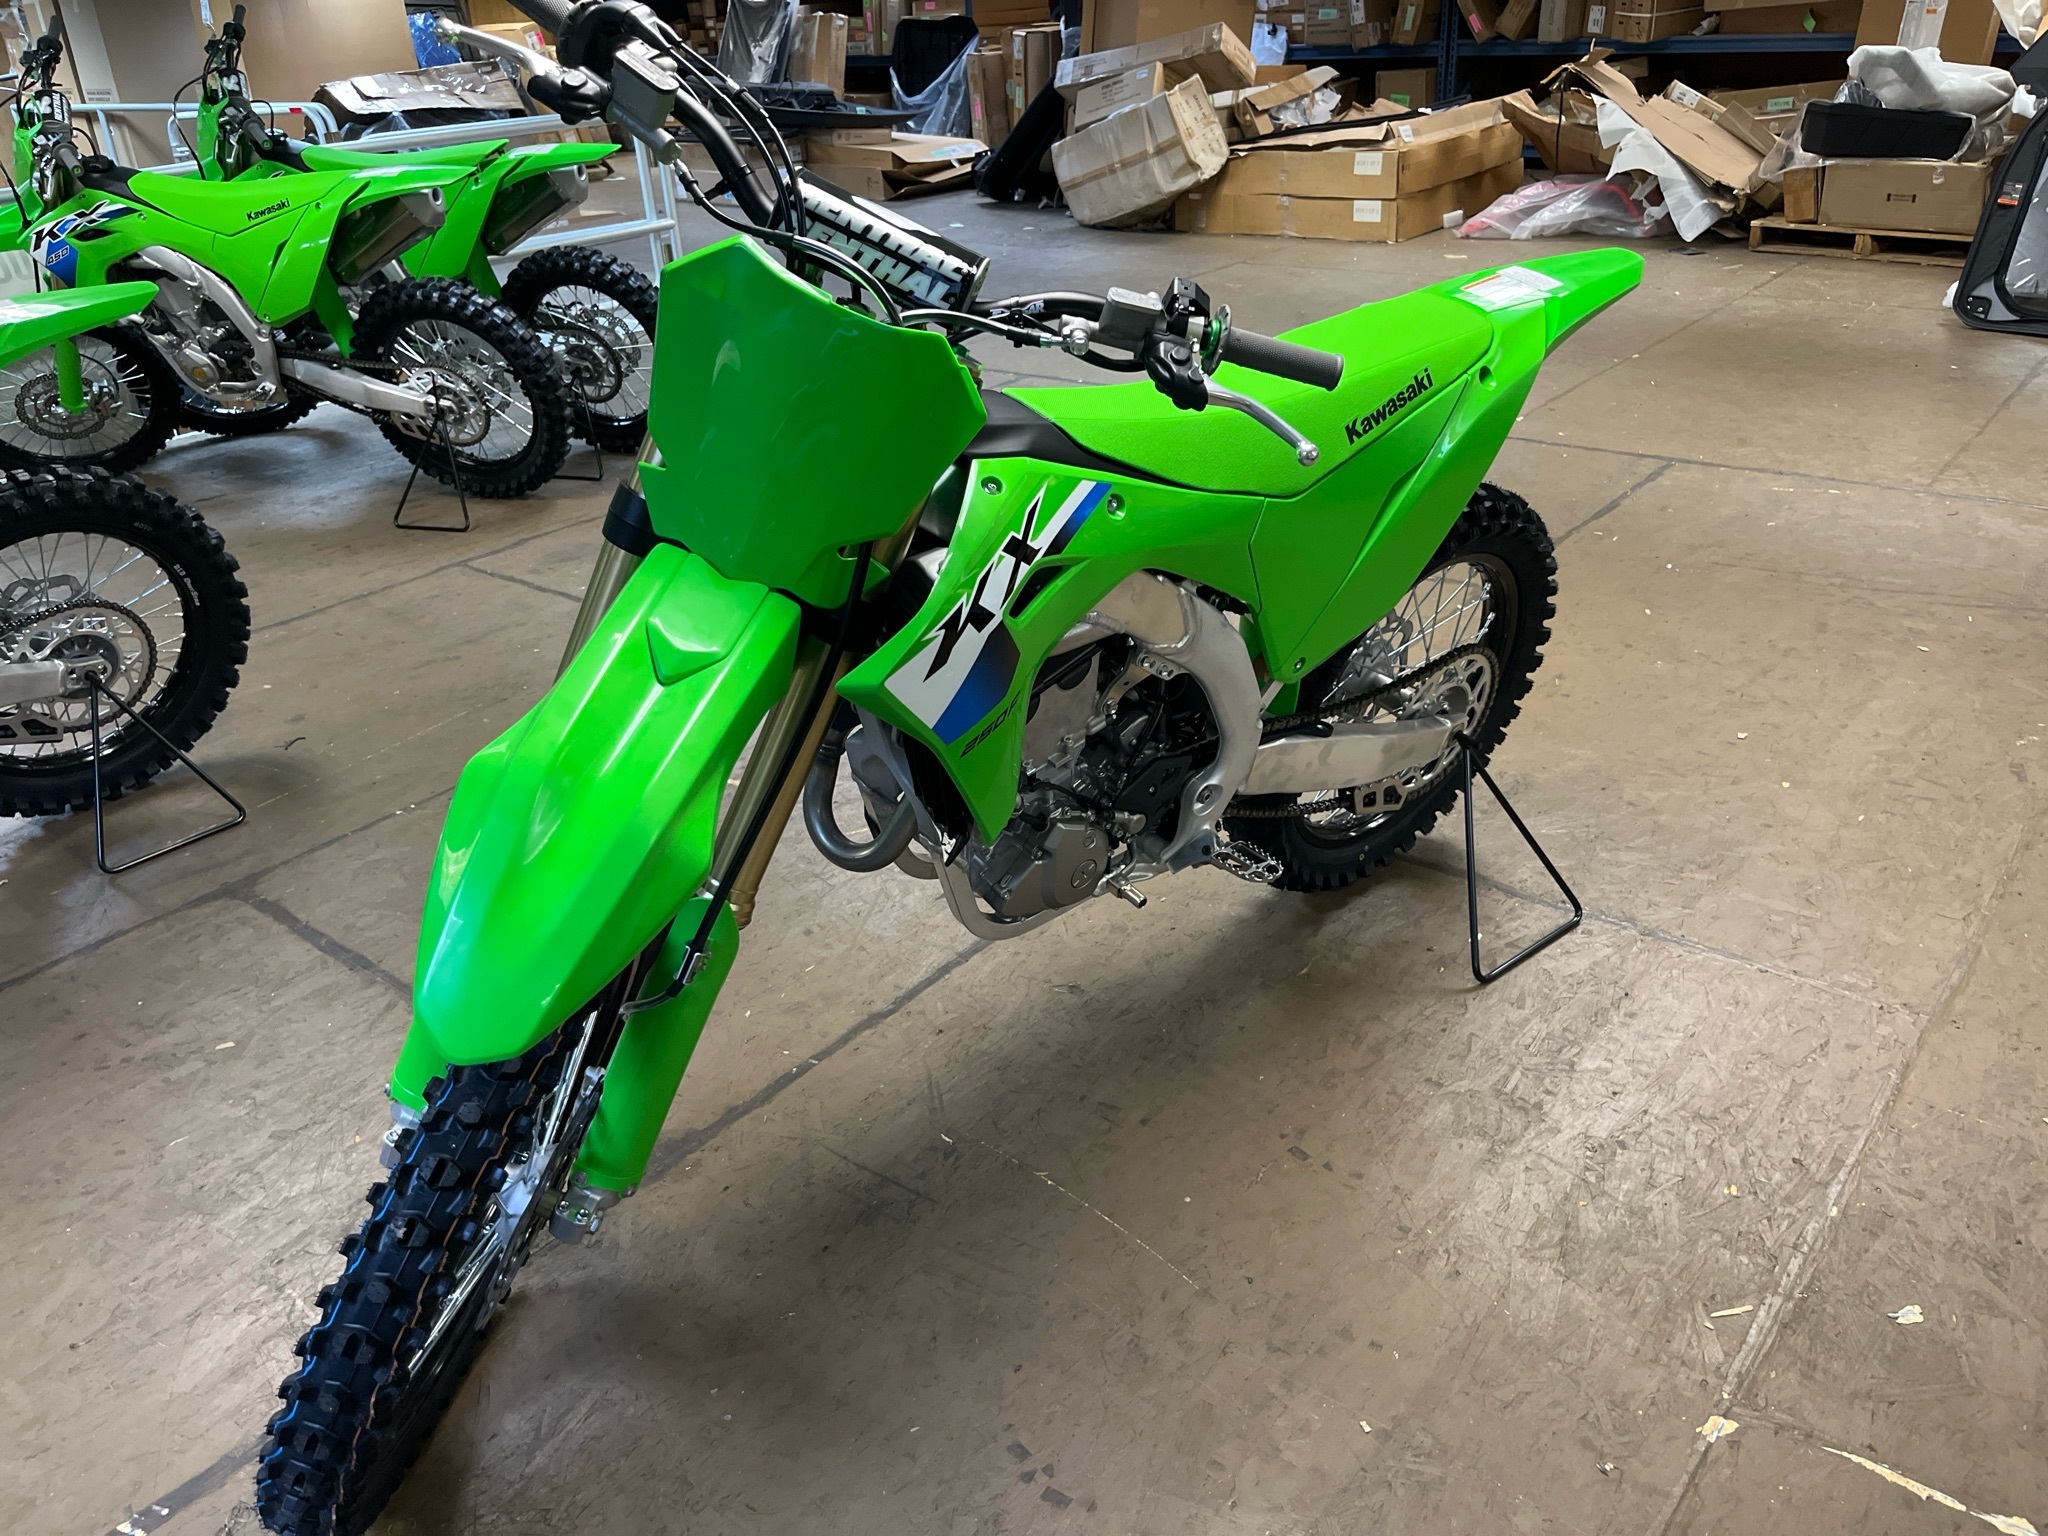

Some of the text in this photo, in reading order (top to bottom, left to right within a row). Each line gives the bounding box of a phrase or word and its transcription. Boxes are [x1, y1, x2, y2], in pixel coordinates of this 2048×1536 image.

[31, 199, 110, 253] KX
[246, 197, 290, 222] Kawasaki
[47, 246, 69, 265] 450
[1344, 367, 1434, 446] Kawasaki
[921, 490, 1044, 683] KX
[960, 689, 1021, 759] 250F
